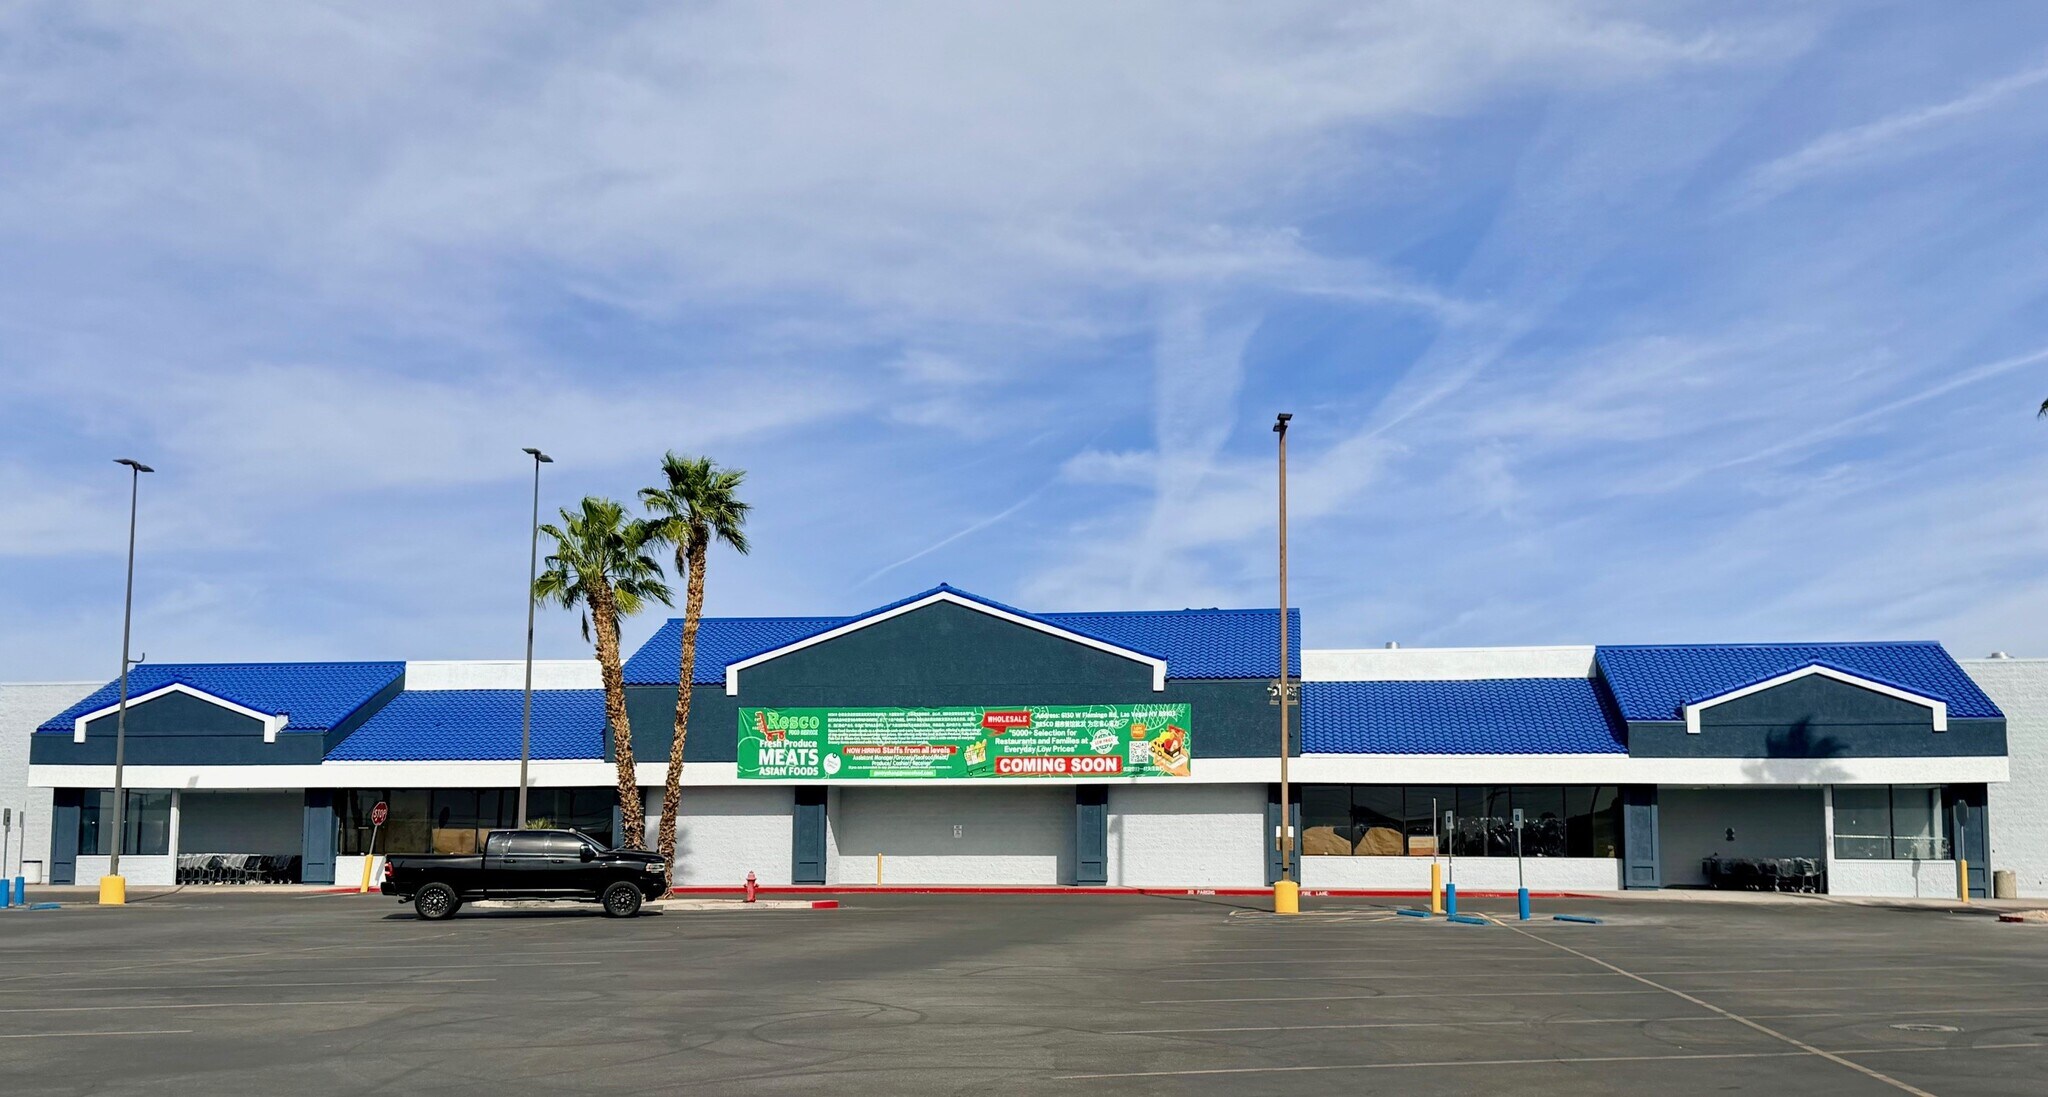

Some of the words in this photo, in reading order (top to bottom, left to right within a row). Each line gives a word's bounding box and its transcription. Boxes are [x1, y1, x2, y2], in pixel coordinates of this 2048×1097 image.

[987, 715, 1027, 723] WHOLESALE
[1131, 711, 1147, 719] Vegas
[767, 712, 820, 729] Resco
[1034, 729, 1065, 737] Selection
[1066, 729, 1077, 737] for
[759, 739, 782, 748] Fresh
[784, 739, 817, 748] Produce
[995, 737, 1036, 745] Restaurants
[1037, 737, 1050, 745] and
[1052, 737, 1079, 745] Families
[1004, 746, 1036, 754] Everyday
[759, 748, 819, 766] MEATS
[999, 758, 1066, 772] COMING
[1071, 757, 1117, 772] SOON
[759, 767, 786, 776] ASIAN
[788, 767, 819, 776] FOODS
[373, 809, 387, 819] STOP
